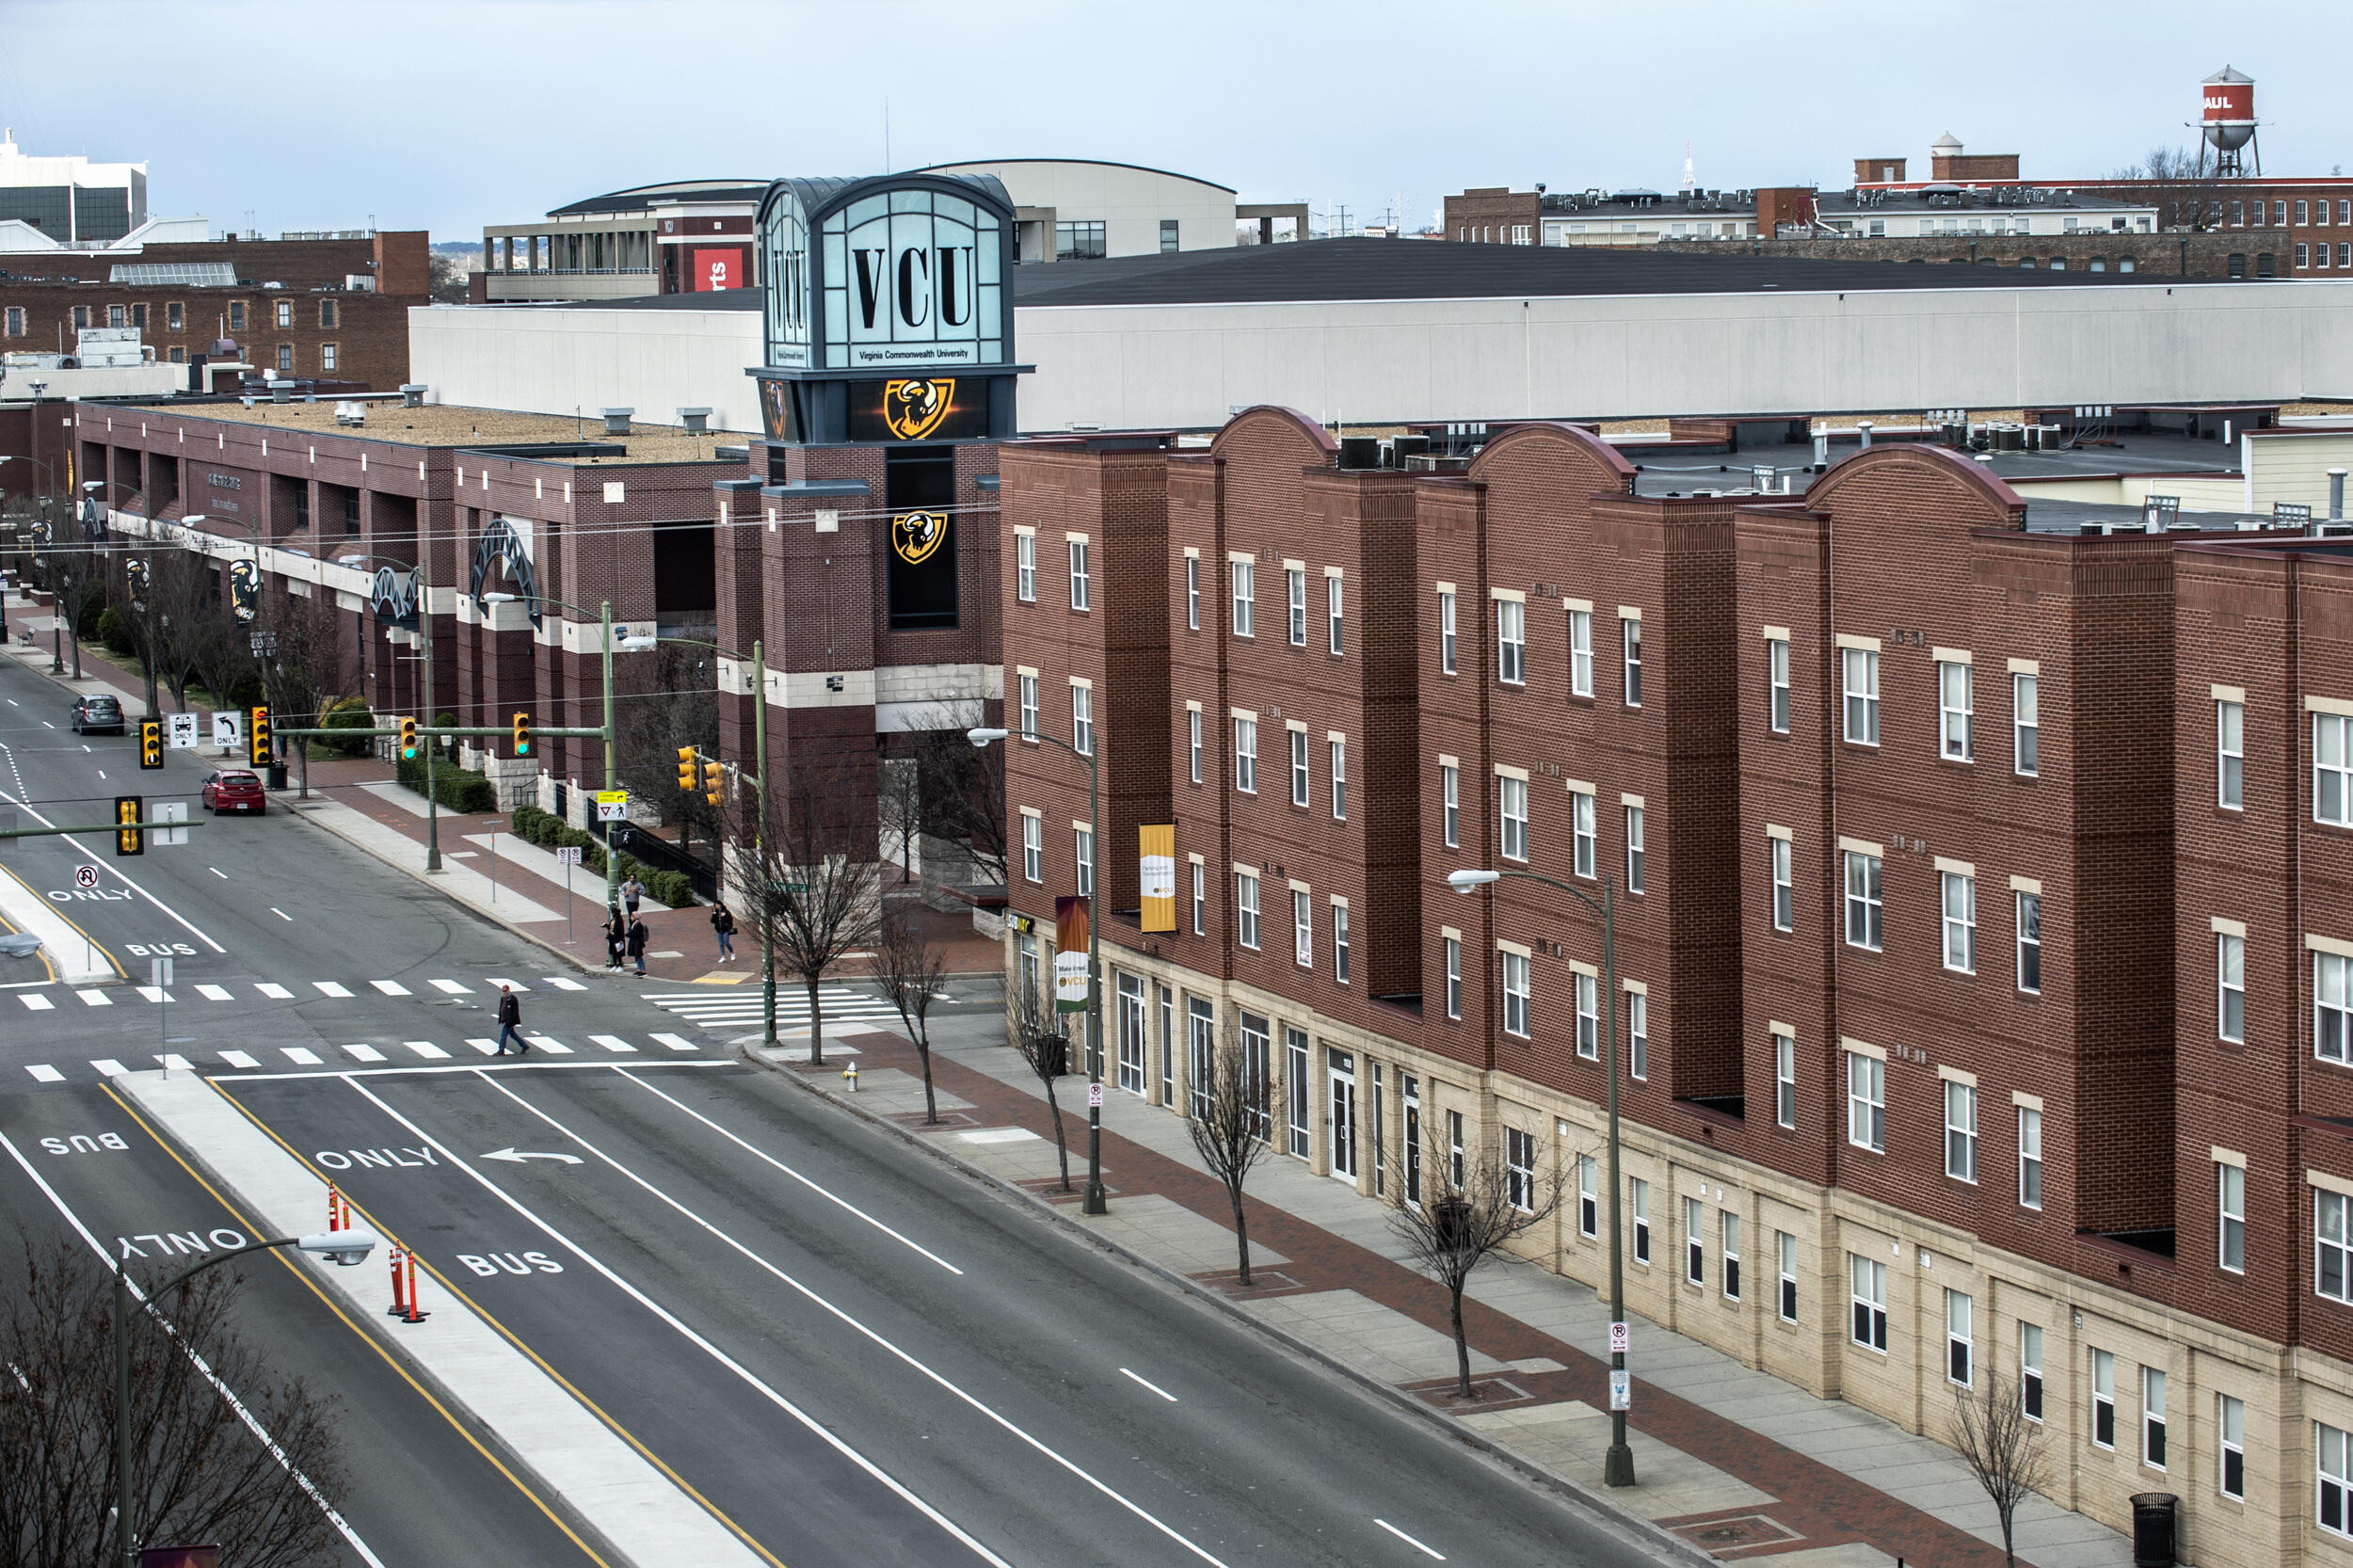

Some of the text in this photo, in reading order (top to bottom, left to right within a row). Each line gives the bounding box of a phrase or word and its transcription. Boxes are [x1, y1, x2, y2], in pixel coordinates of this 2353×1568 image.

[2203, 96, 2233, 109] AUL
[774, 249, 805, 328] VCU
[852, 247, 973, 328] VCU
[859, 348, 968, 361] Virginia Commonwealth University
[47, 888, 134, 902] ONLY
[124, 943, 198, 956] BUS
[1066, 976, 1087, 985] VCU
[40, 1132, 130, 1155] BUS
[315, 1147, 439, 1170] ONLY
[117, 1228, 247, 1259] ONLY
[456, 1251, 565, 1276] BUS
